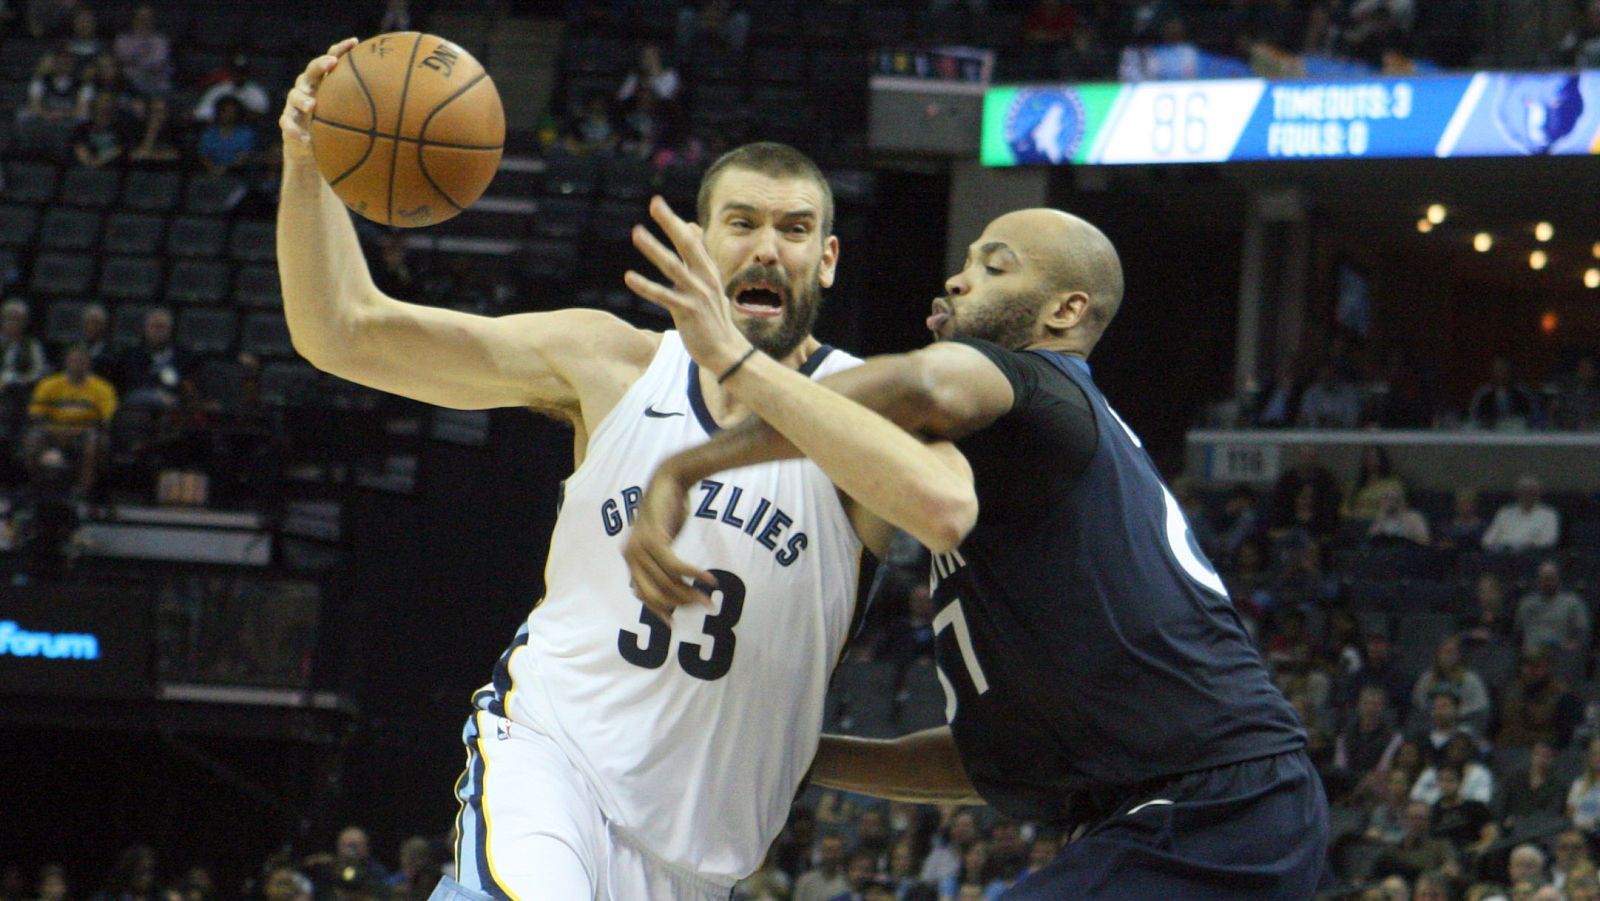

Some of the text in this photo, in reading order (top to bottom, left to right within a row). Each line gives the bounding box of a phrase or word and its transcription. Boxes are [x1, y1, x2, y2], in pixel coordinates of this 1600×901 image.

[1152, 92, 1209, 154] 86
[1272, 82, 1412, 120] TIMEOUTS: 3
[1268, 121, 1344, 157] FOULS:
[601, 479, 808, 567] GRZLIES
